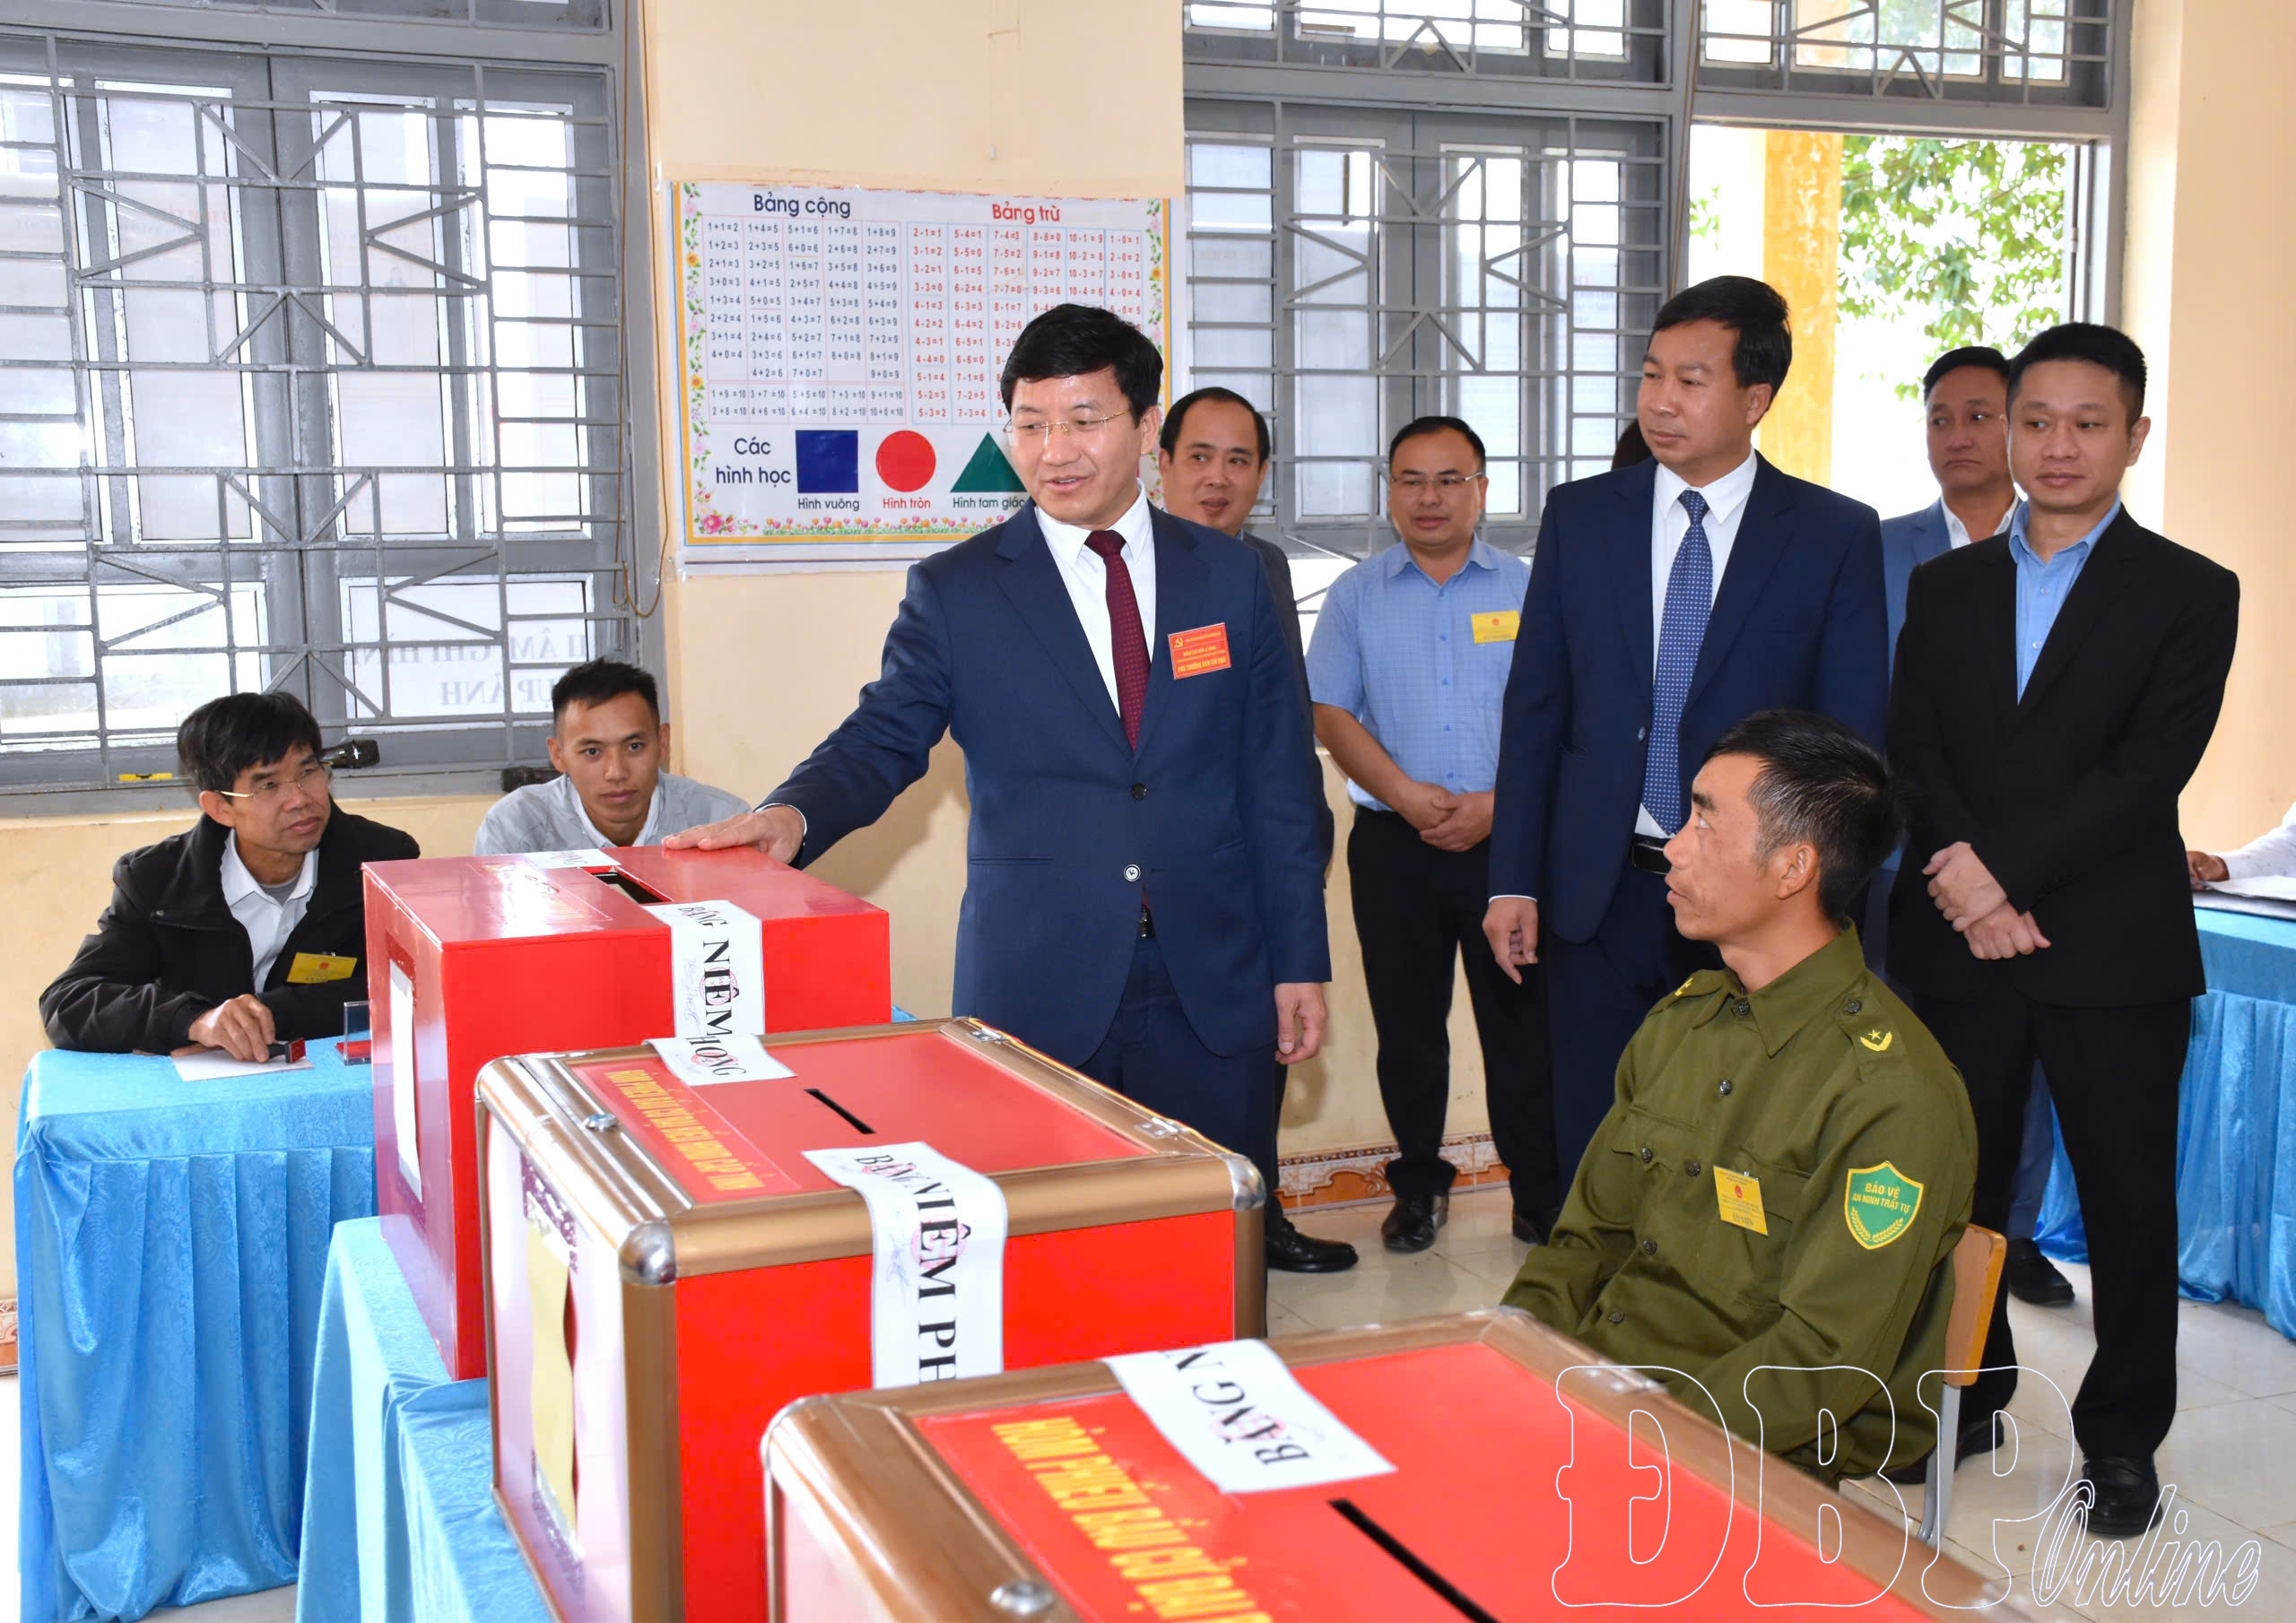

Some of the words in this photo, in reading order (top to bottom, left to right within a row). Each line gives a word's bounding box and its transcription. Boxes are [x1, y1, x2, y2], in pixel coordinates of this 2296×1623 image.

[753, 192, 799, 217] Bảng
[805, 196, 850, 218] cộng
[992, 201, 1035, 225] Bảng
[1039, 204, 1061, 222] trừ
[734, 437, 771, 456] Các
[716, 466, 753, 484] hình
[758, 467, 791, 488] học
[797, 497, 822, 510] Hình
[824, 498, 860, 512] vuông
[883, 497, 907, 509] Hình
[909, 498, 931, 509] tròn
[952, 497, 976, 508] Hình
[978, 498, 999, 508] tam
[1002, 496, 1026, 511] giác
[702, 937, 740, 1036] NIÊM
[685, 1037, 747, 1076] HONG
[1866, 1180, 1885, 1194] BẢO
[1887, 1185, 1900, 1201] VỆ
[906, 1181, 971, 1302] NIÊM
